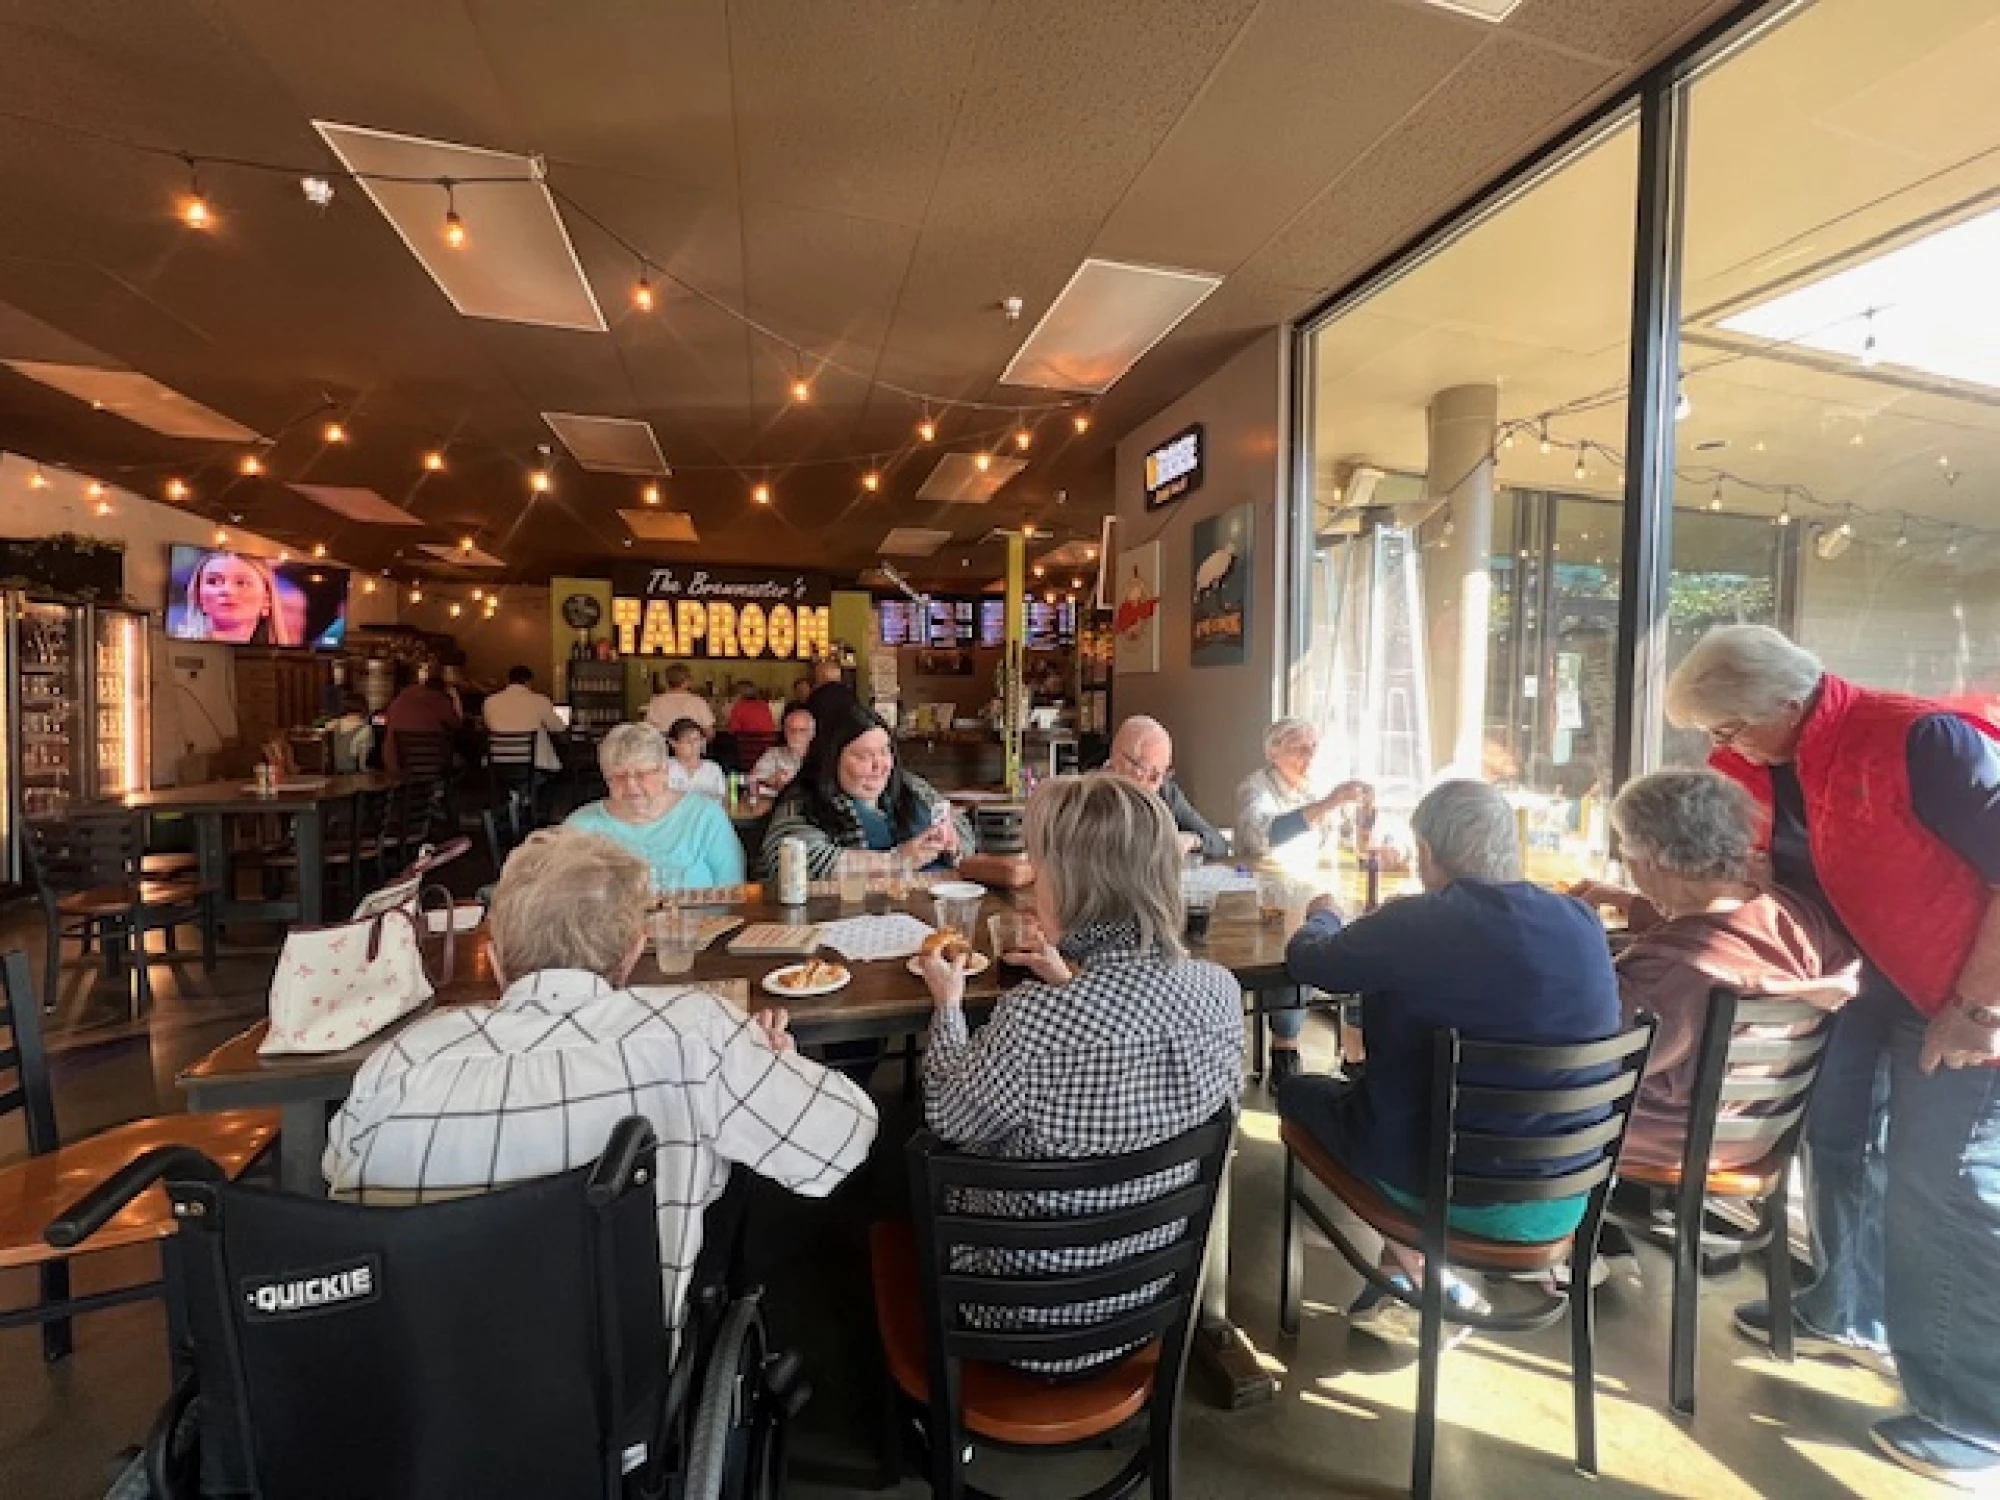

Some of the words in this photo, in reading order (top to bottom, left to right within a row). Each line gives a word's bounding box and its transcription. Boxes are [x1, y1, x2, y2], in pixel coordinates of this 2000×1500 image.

[646, 568, 681, 594] The
[612, 597, 829, 658] TAPROOM
[256, 1266, 371, 1312] QUICKIE
